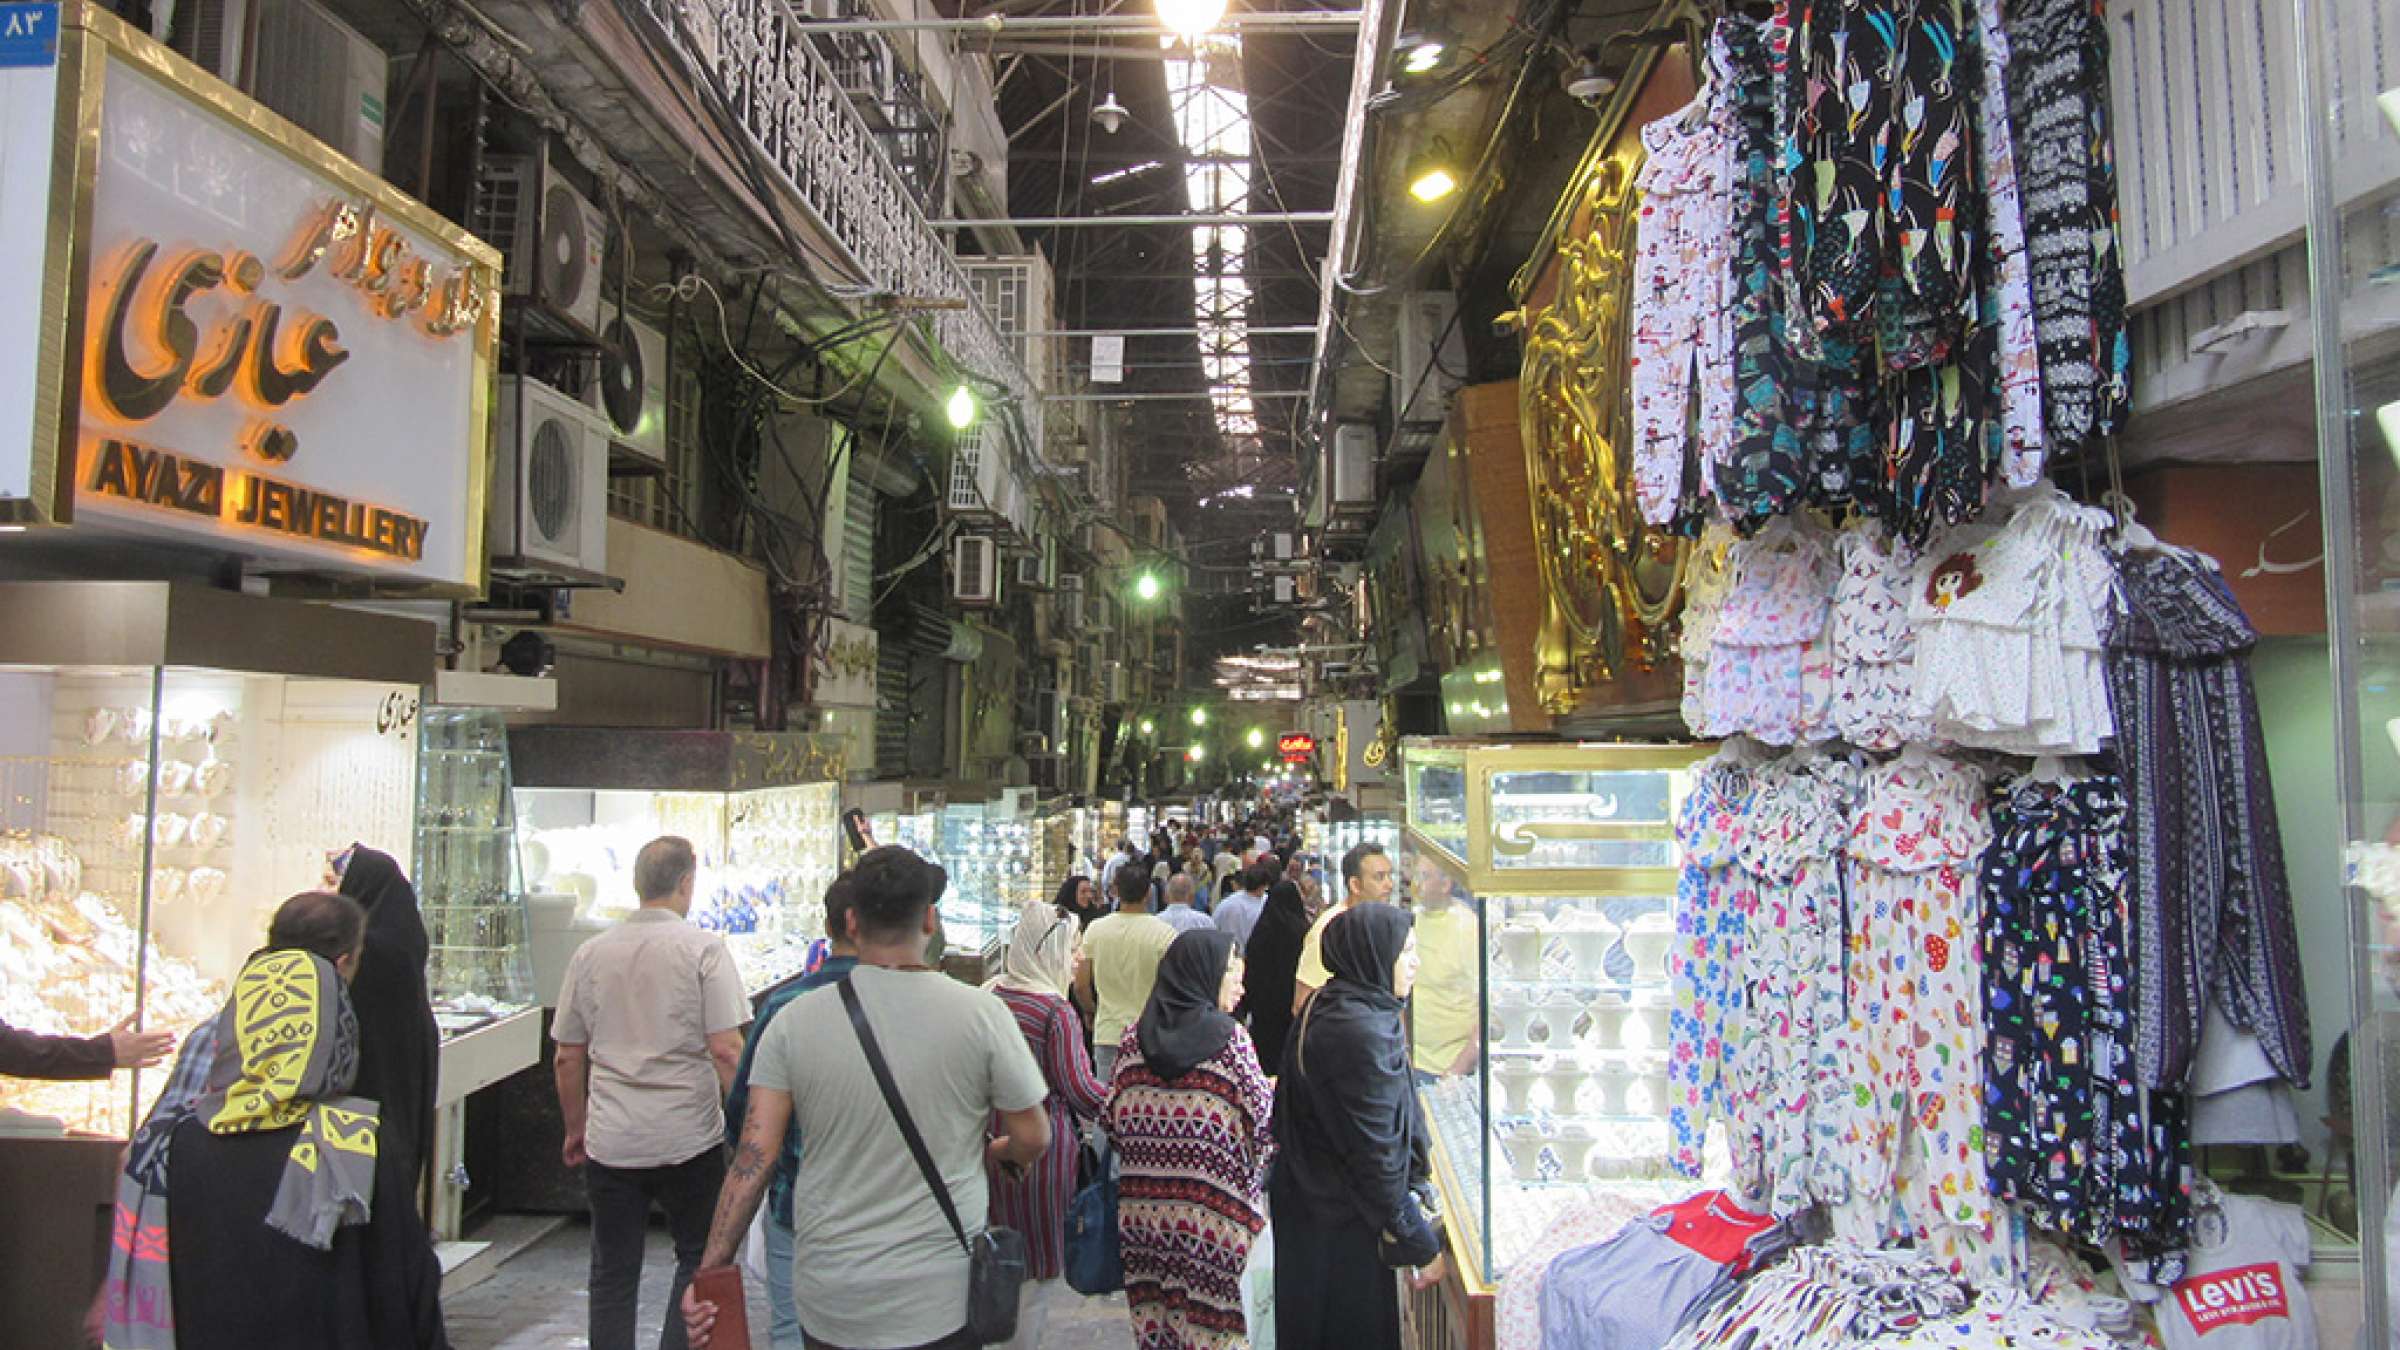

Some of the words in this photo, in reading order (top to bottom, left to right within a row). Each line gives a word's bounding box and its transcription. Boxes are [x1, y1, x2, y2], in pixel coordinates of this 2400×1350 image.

[5, 11, 43, 38] ۸۳
[91, 439, 225, 517] AYAZI
[236, 475, 431, 560] JEWELLERY
